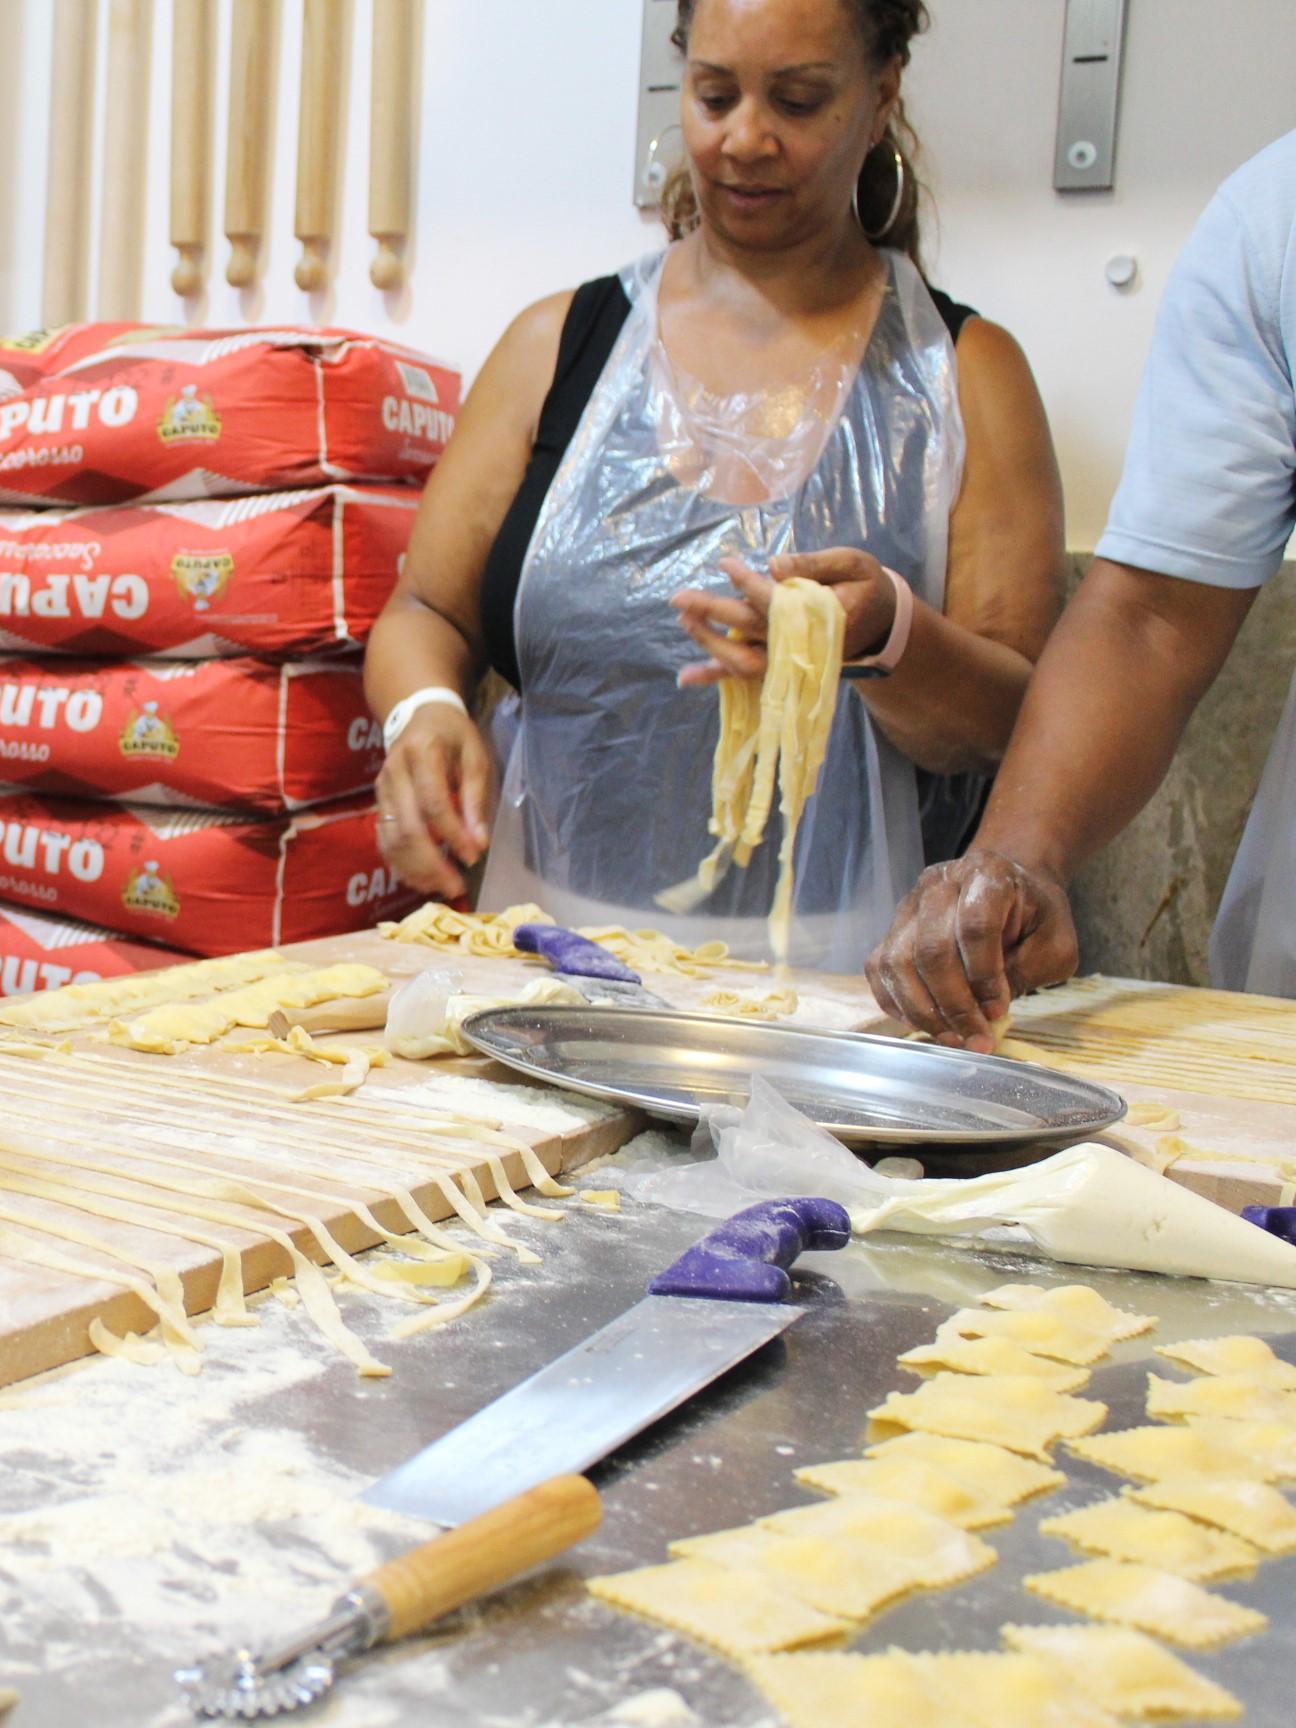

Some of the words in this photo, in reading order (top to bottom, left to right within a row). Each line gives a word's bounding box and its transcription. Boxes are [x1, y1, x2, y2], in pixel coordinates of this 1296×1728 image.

[161, 423, 219, 437] CAPUTO
[175, 556, 231, 569] CAPUTO
[122, 741, 177, 754] CAPUTO
[125, 896, 177, 912] CAPUTO
